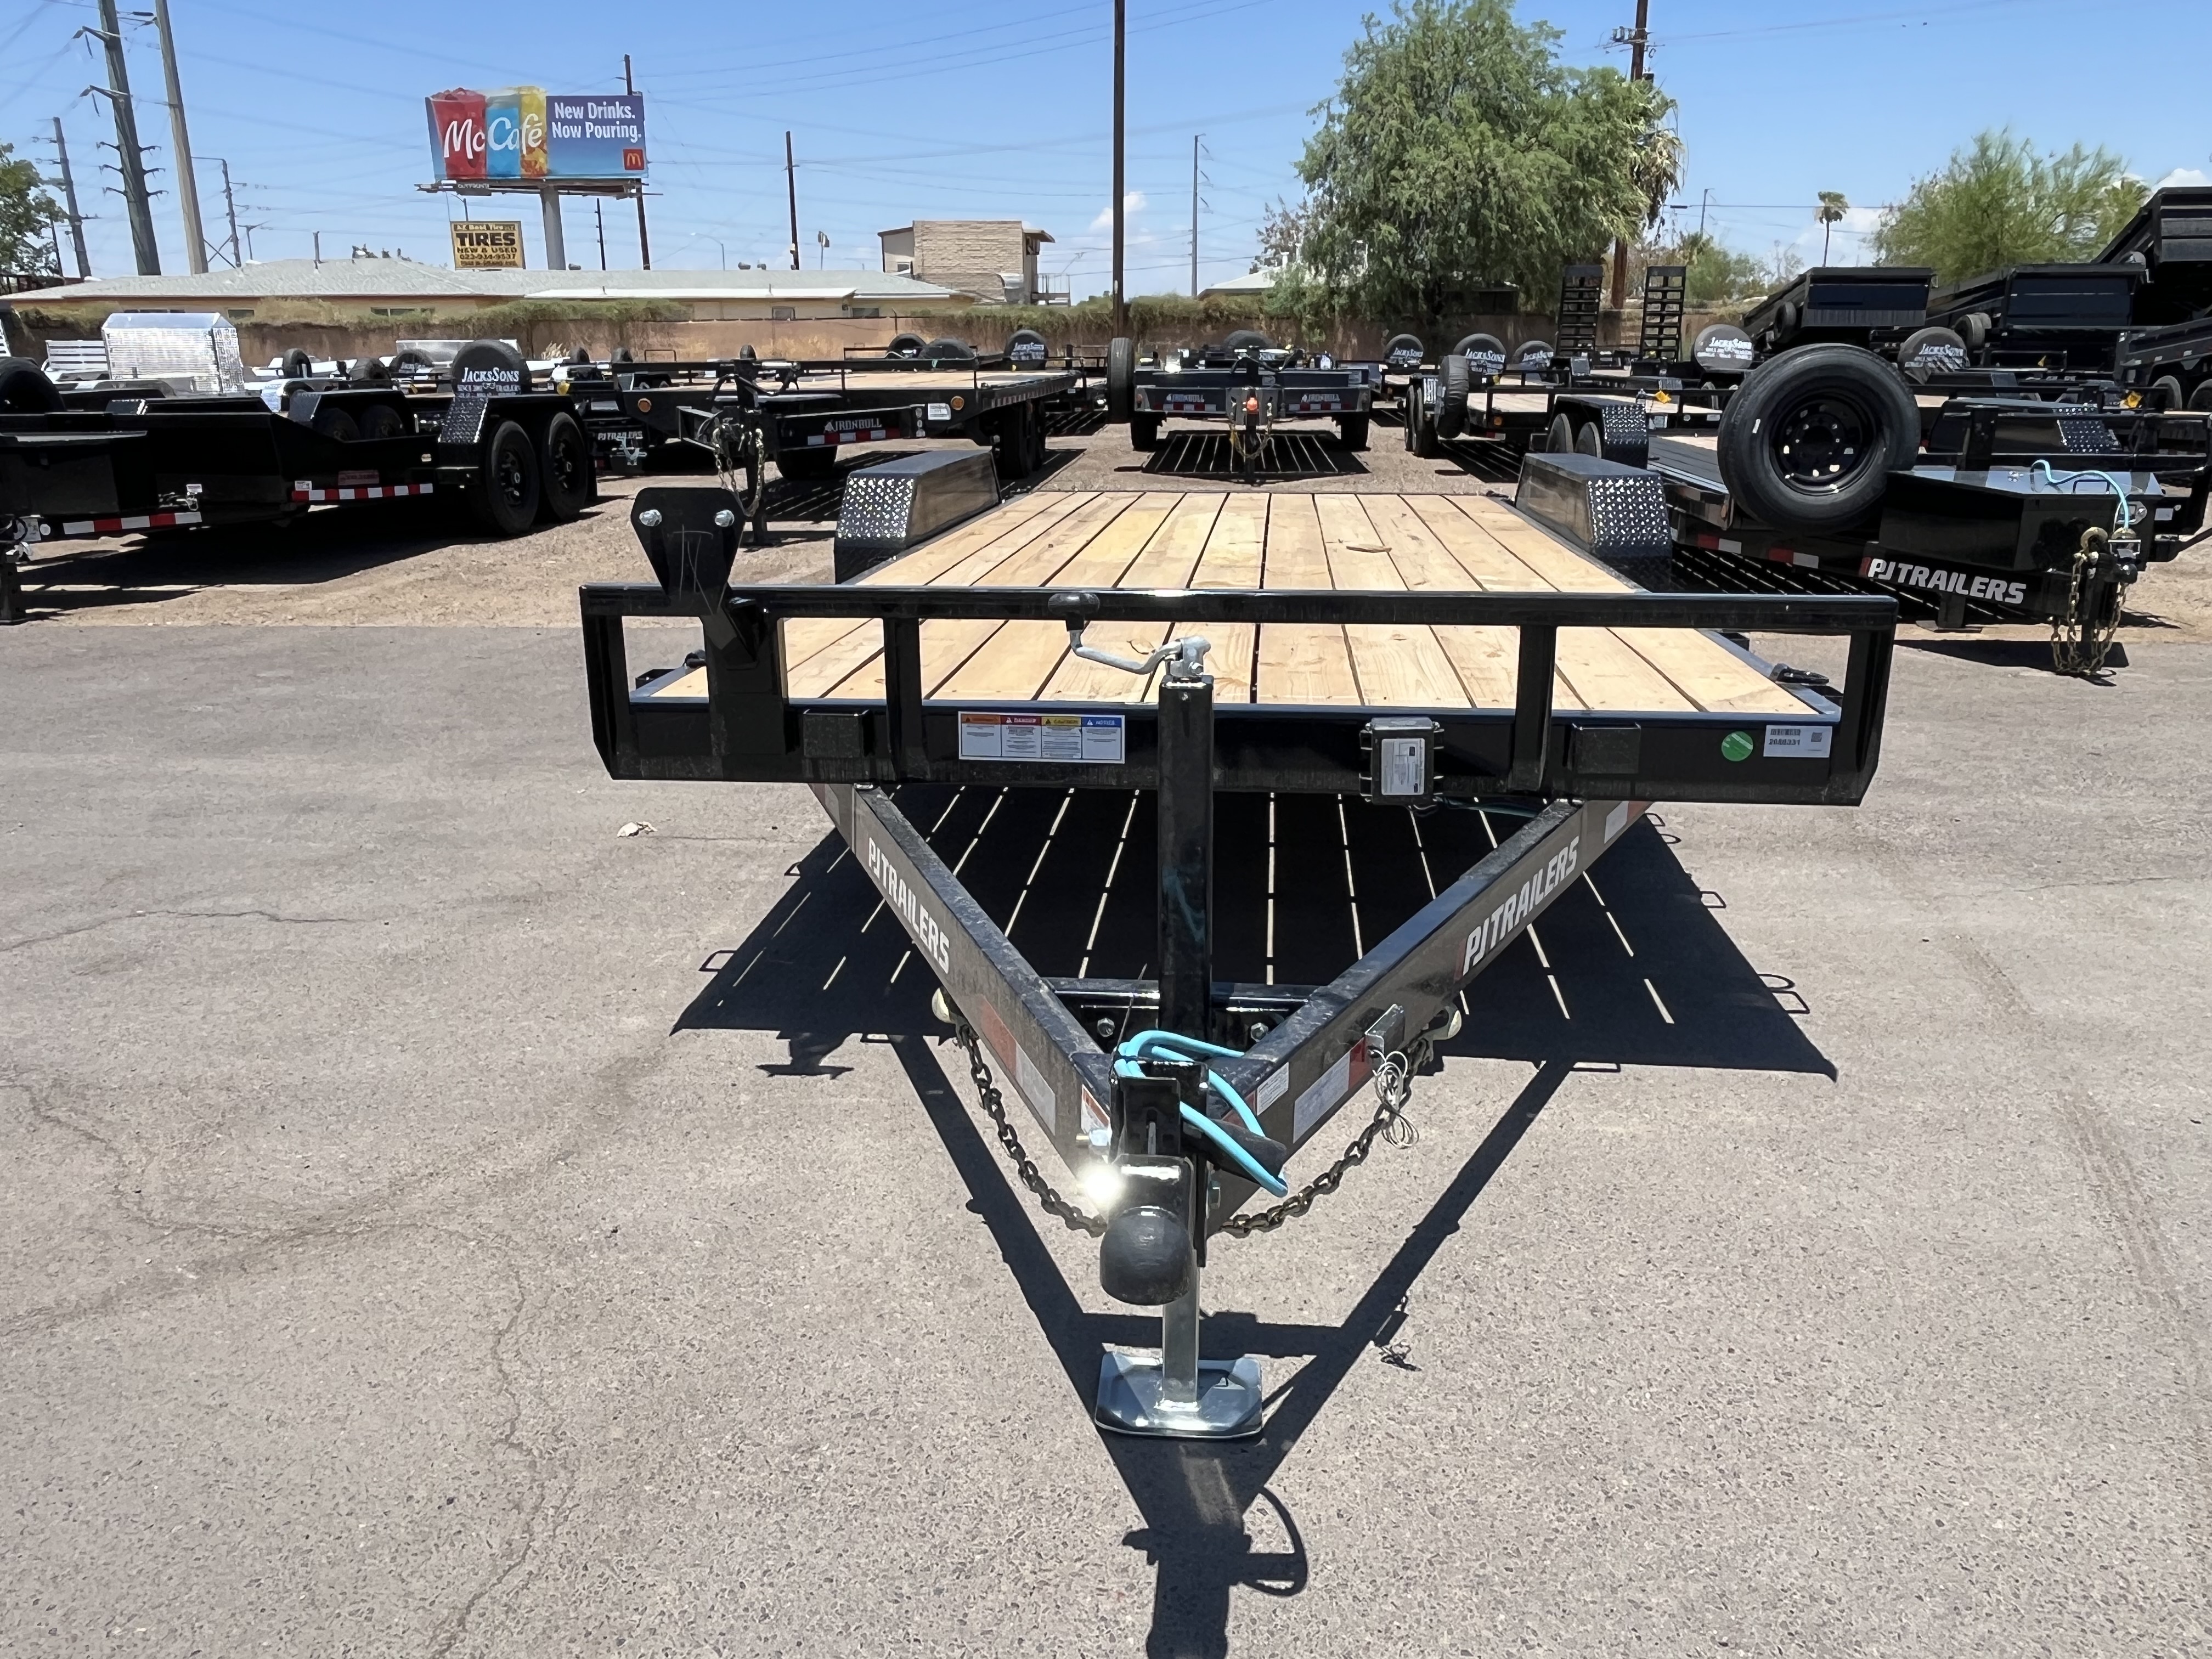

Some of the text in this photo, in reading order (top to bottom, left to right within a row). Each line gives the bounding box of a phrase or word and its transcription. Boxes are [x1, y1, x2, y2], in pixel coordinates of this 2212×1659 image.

[554, 101, 636, 120] New Drinks.
[552, 121, 642, 143] Now Pouring.
[455, 232, 516, 246] TIRES
[1867, 558, 2027, 604] PJ TRAILERS
[868, 837, 950, 974] PJ TRAILERS
[1463, 836, 1579, 976] PJ TRAILERS
